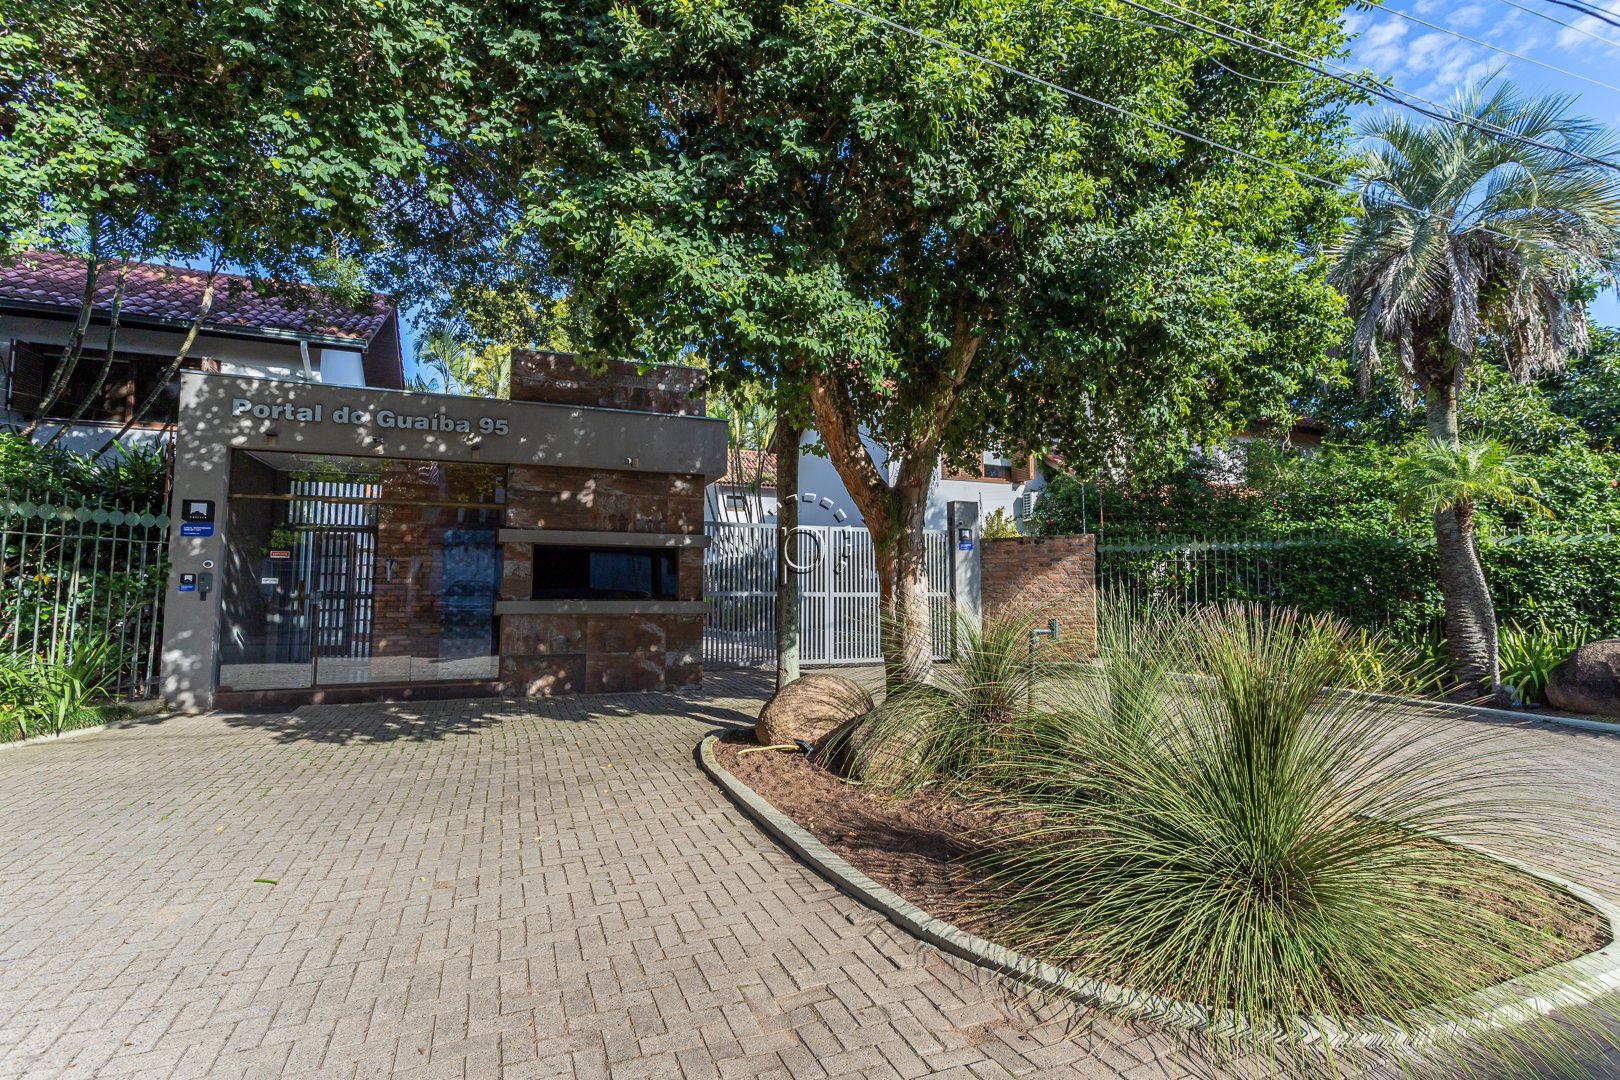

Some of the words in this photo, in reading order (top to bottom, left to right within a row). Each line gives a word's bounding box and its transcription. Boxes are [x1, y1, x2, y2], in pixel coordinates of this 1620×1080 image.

[232, 398, 322, 422] Portal
[332, 407, 366, 425] do
[479, 417, 509, 435] 95
